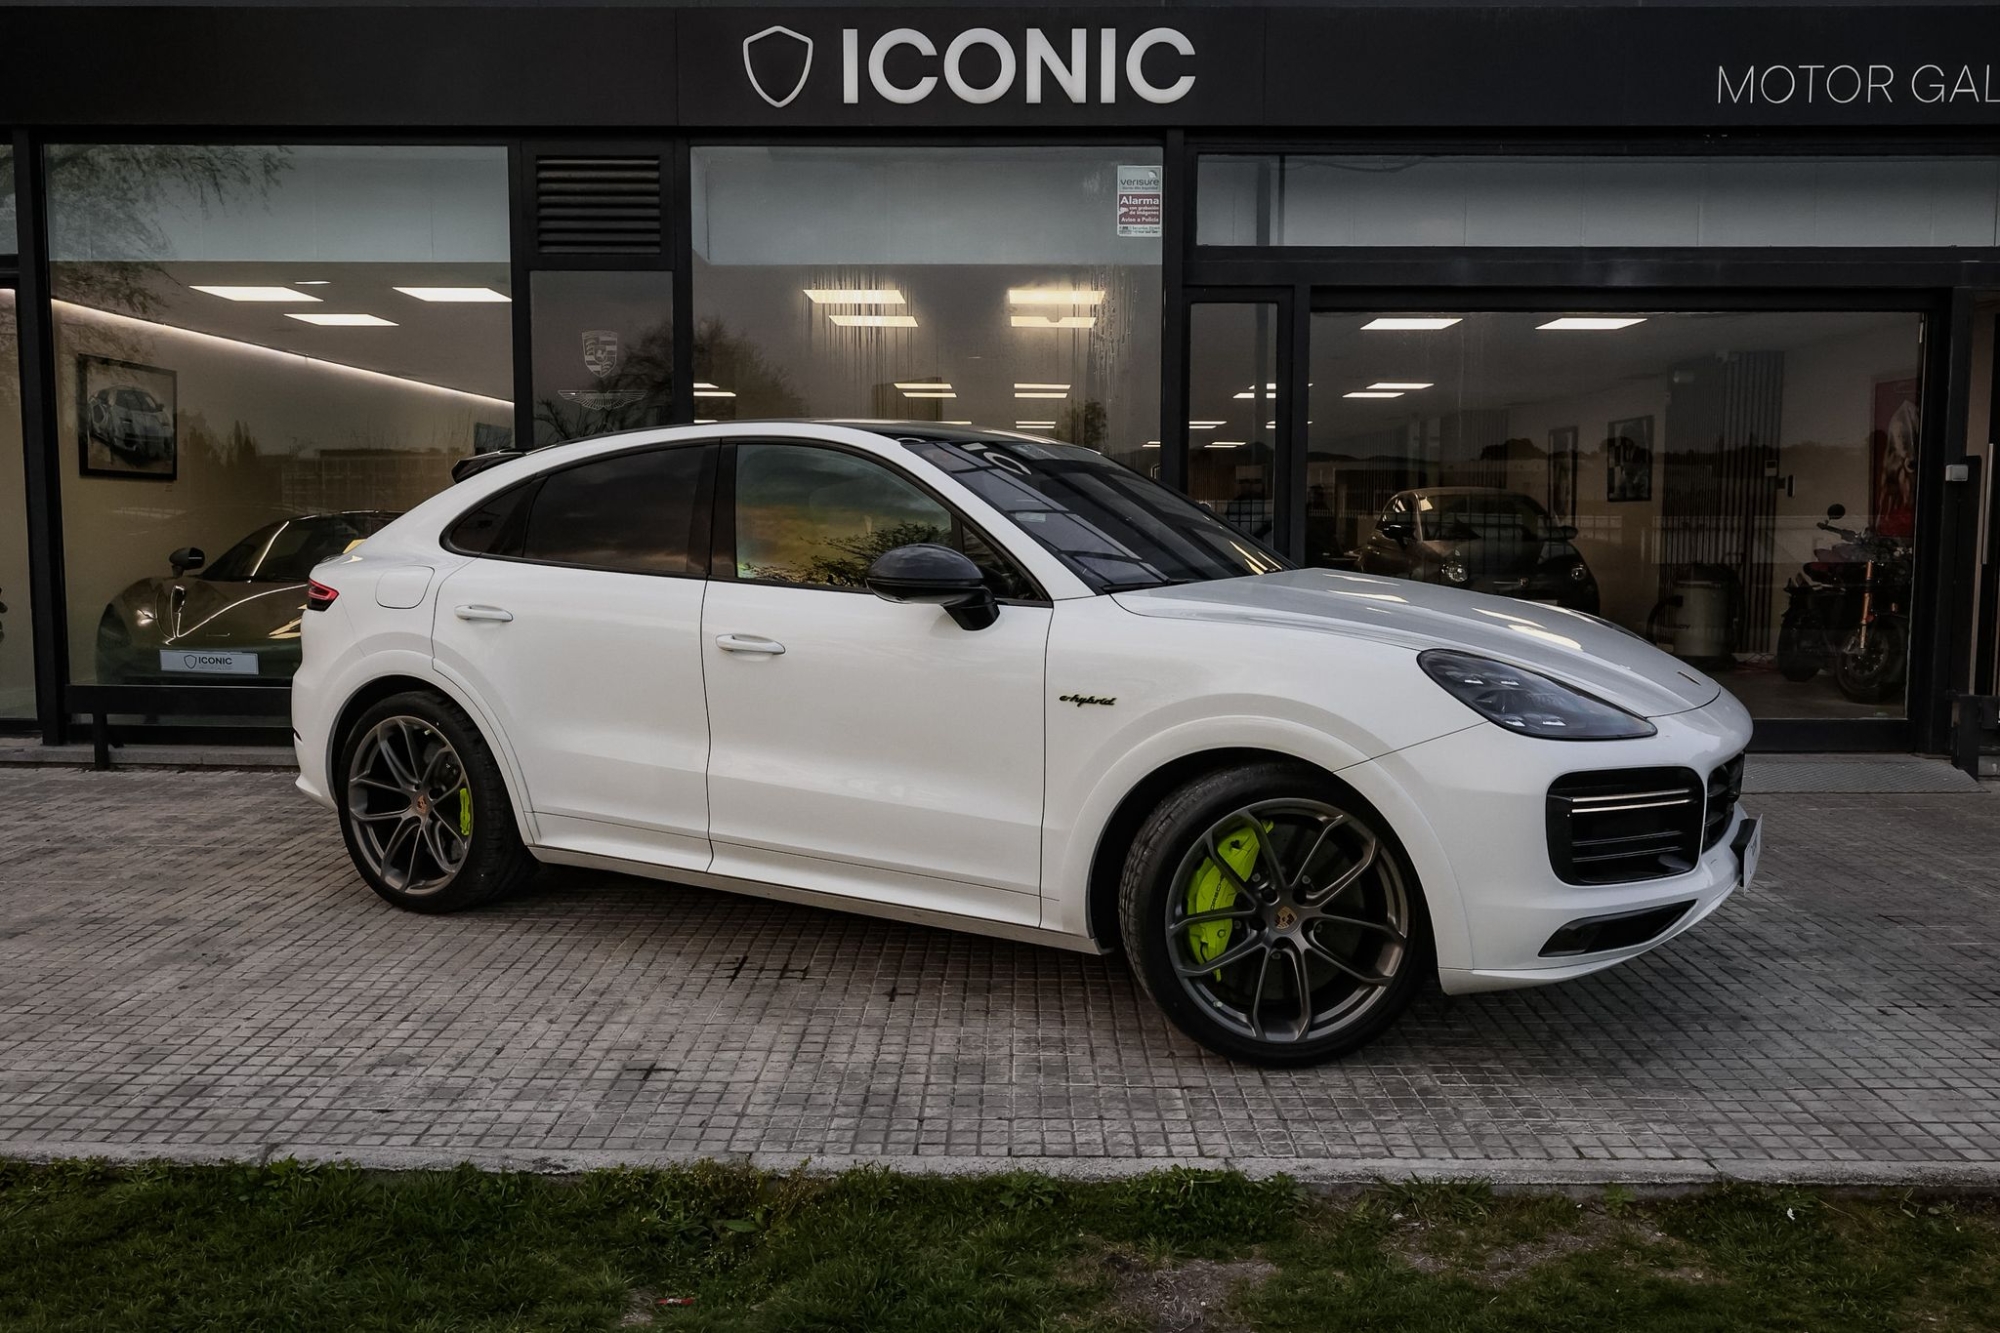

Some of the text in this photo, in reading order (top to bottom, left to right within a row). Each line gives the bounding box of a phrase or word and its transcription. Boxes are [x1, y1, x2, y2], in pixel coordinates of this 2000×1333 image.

[843, 27, 1196, 104] ICONIC
[1718, 64, 1894, 104] MOTOR
[1120, 195, 1159, 204] Alarma
[198, 656, 233, 665] ICONIC
